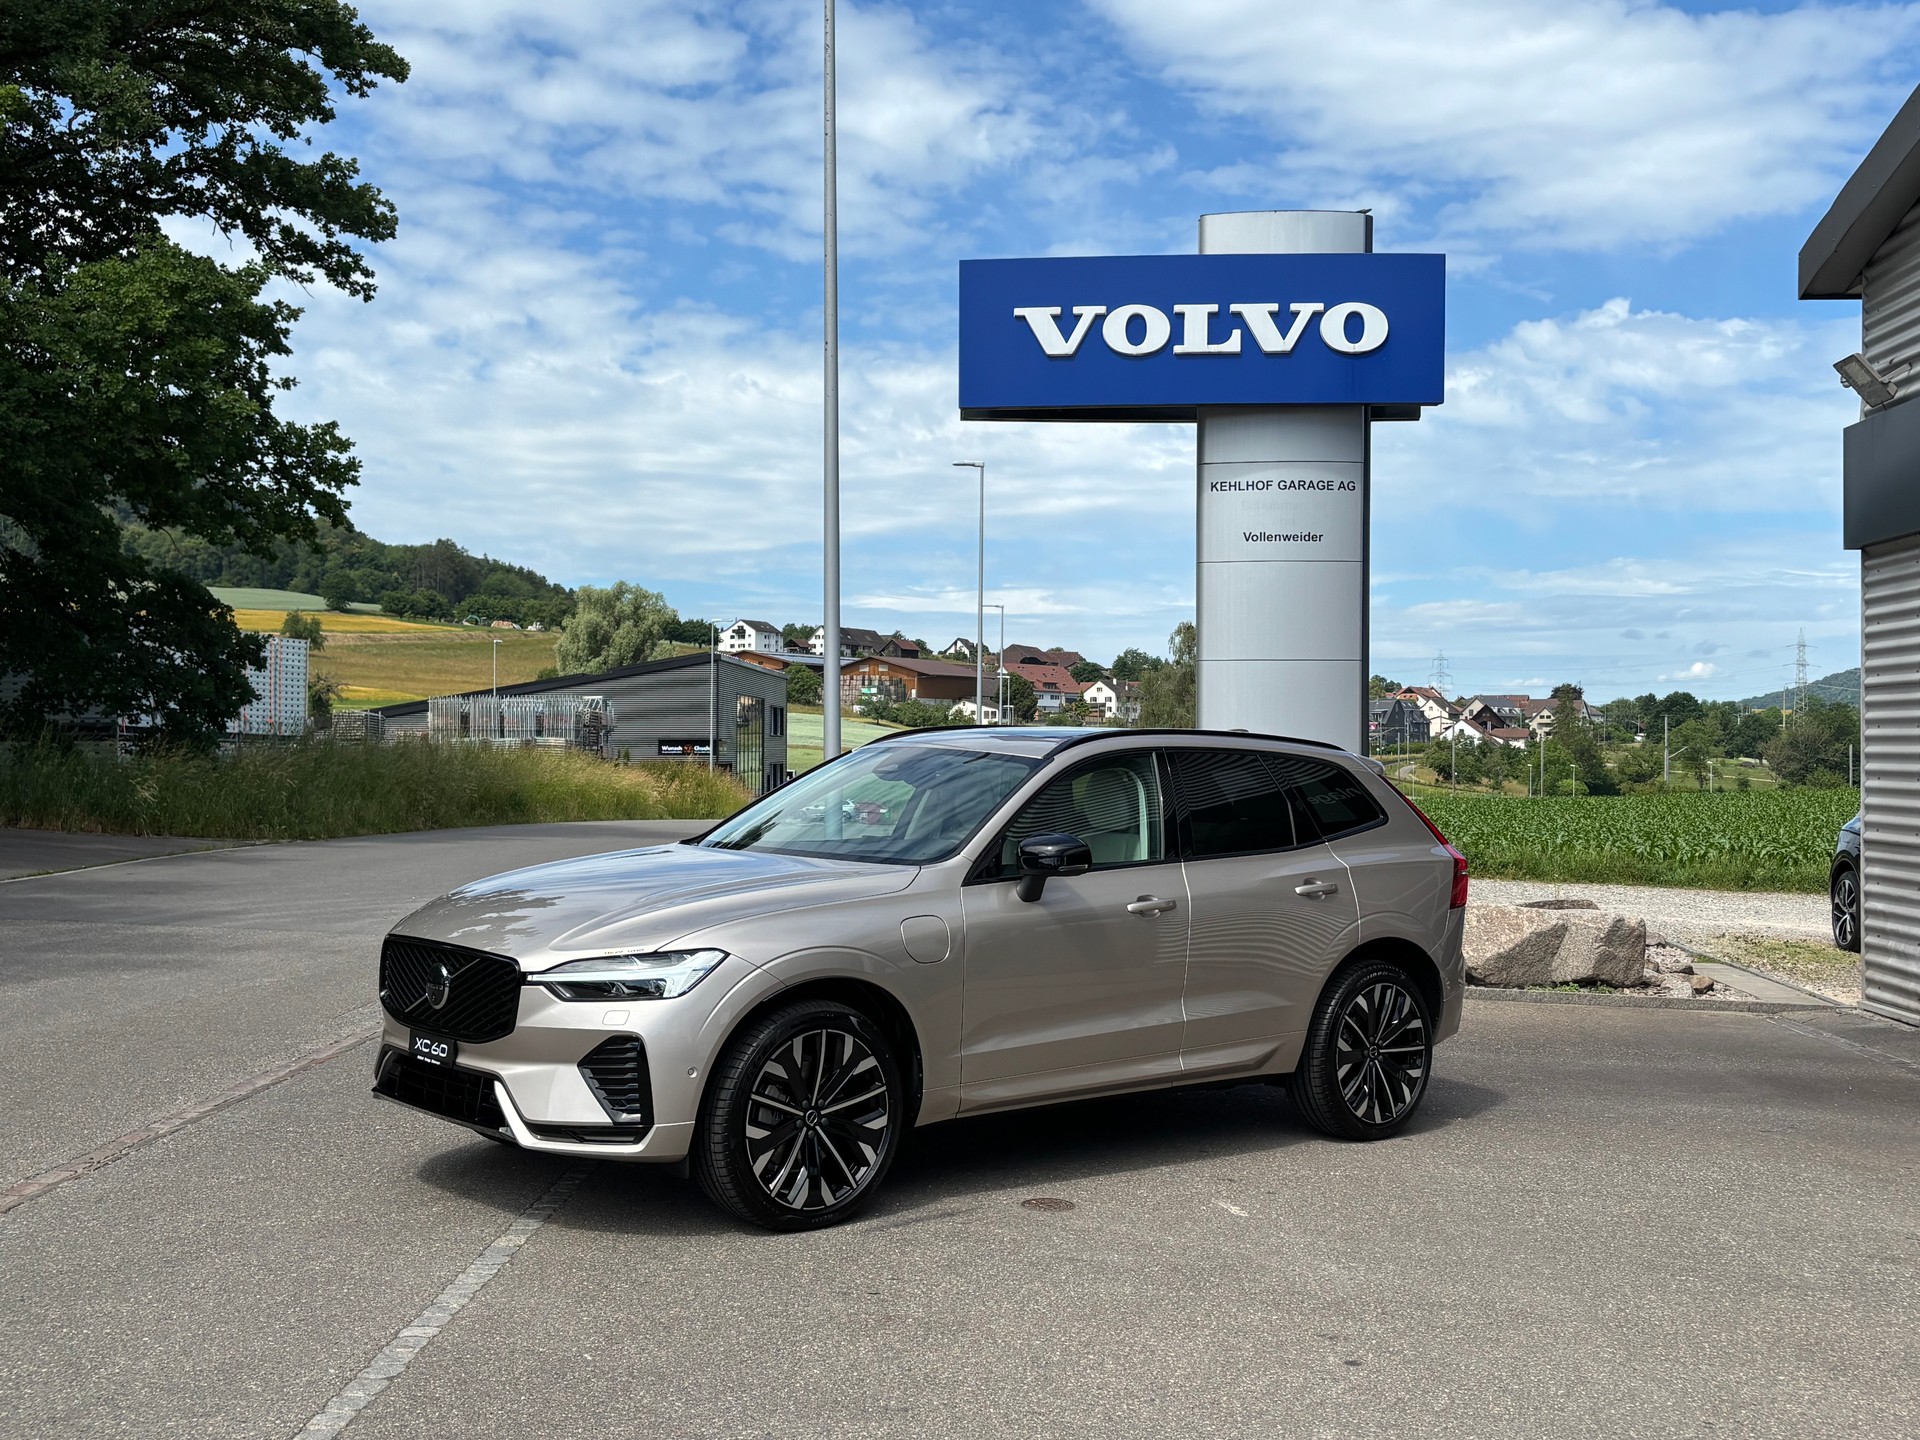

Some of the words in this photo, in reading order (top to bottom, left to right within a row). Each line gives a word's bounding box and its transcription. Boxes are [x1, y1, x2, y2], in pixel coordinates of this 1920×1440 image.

[1013, 302, 1389, 357] VOLVO
[1210, 480, 1274, 492] KEHLHOF
[1277, 480, 1335, 491] GARAGE
[1337, 480, 1356, 491] AG
[1243, 531, 1324, 542] Vollenweider
[414, 1036, 448, 1057] XC60
